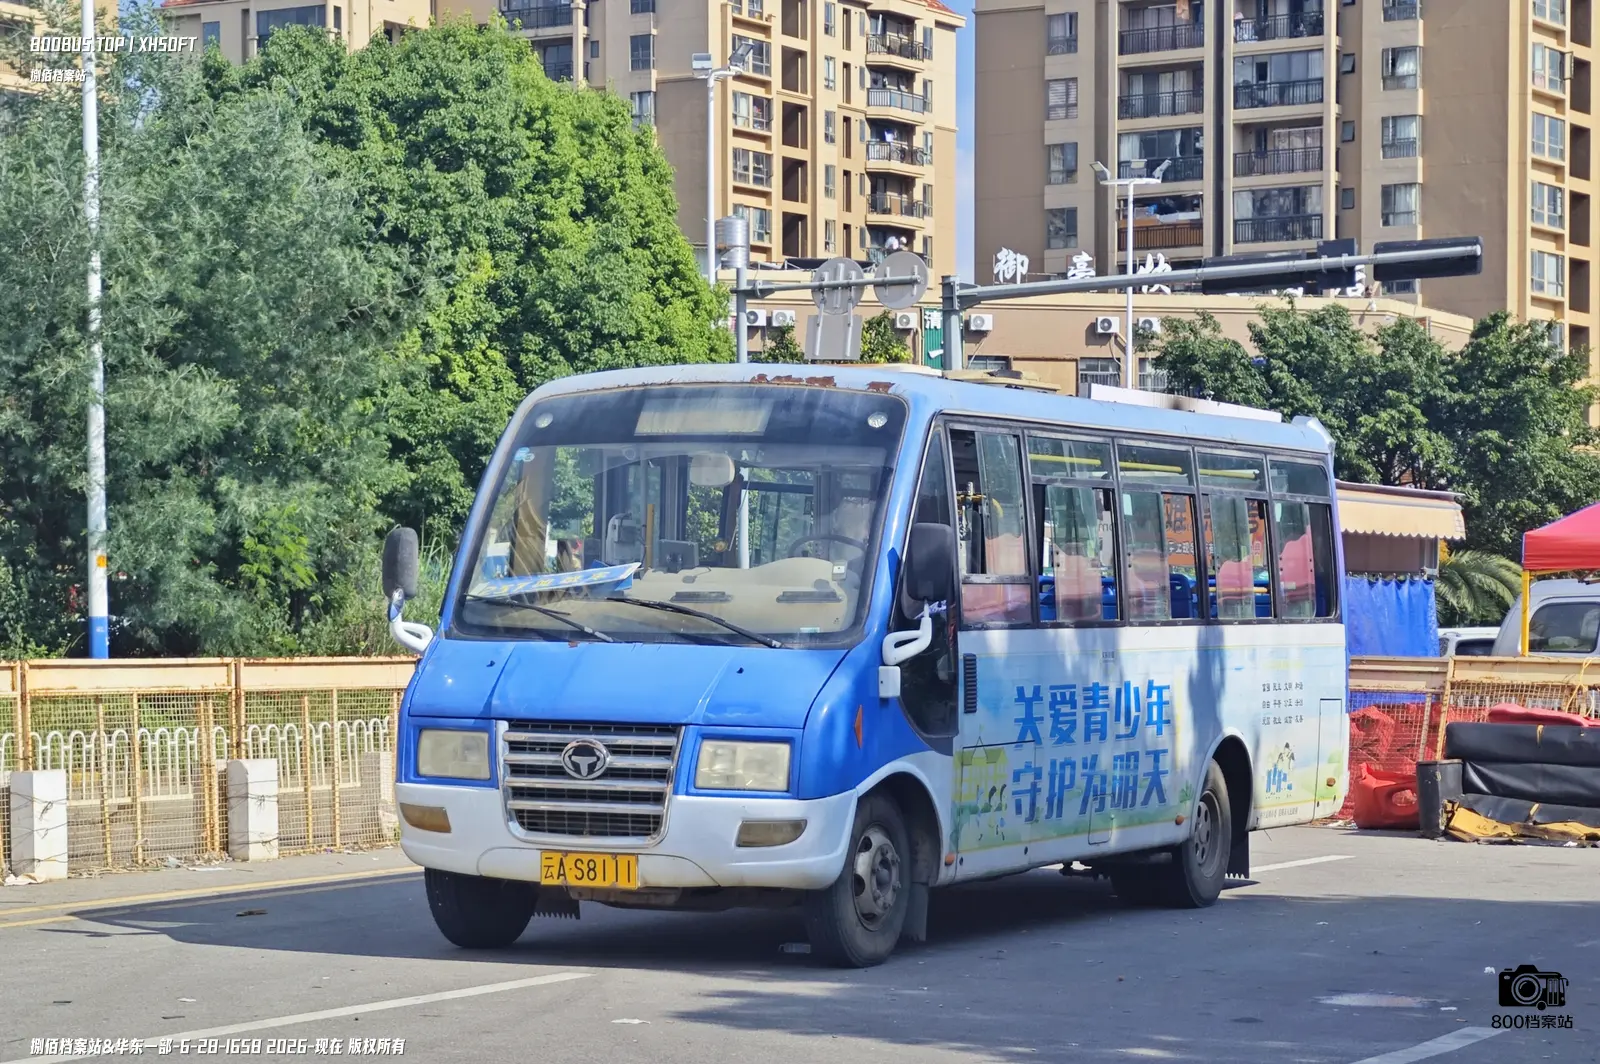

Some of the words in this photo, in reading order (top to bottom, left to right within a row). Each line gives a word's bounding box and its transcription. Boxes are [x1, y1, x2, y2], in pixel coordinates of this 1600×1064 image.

[1013, 679, 1171, 748] 关爱青少年
[1012, 749, 1169, 823] 守护为明天
